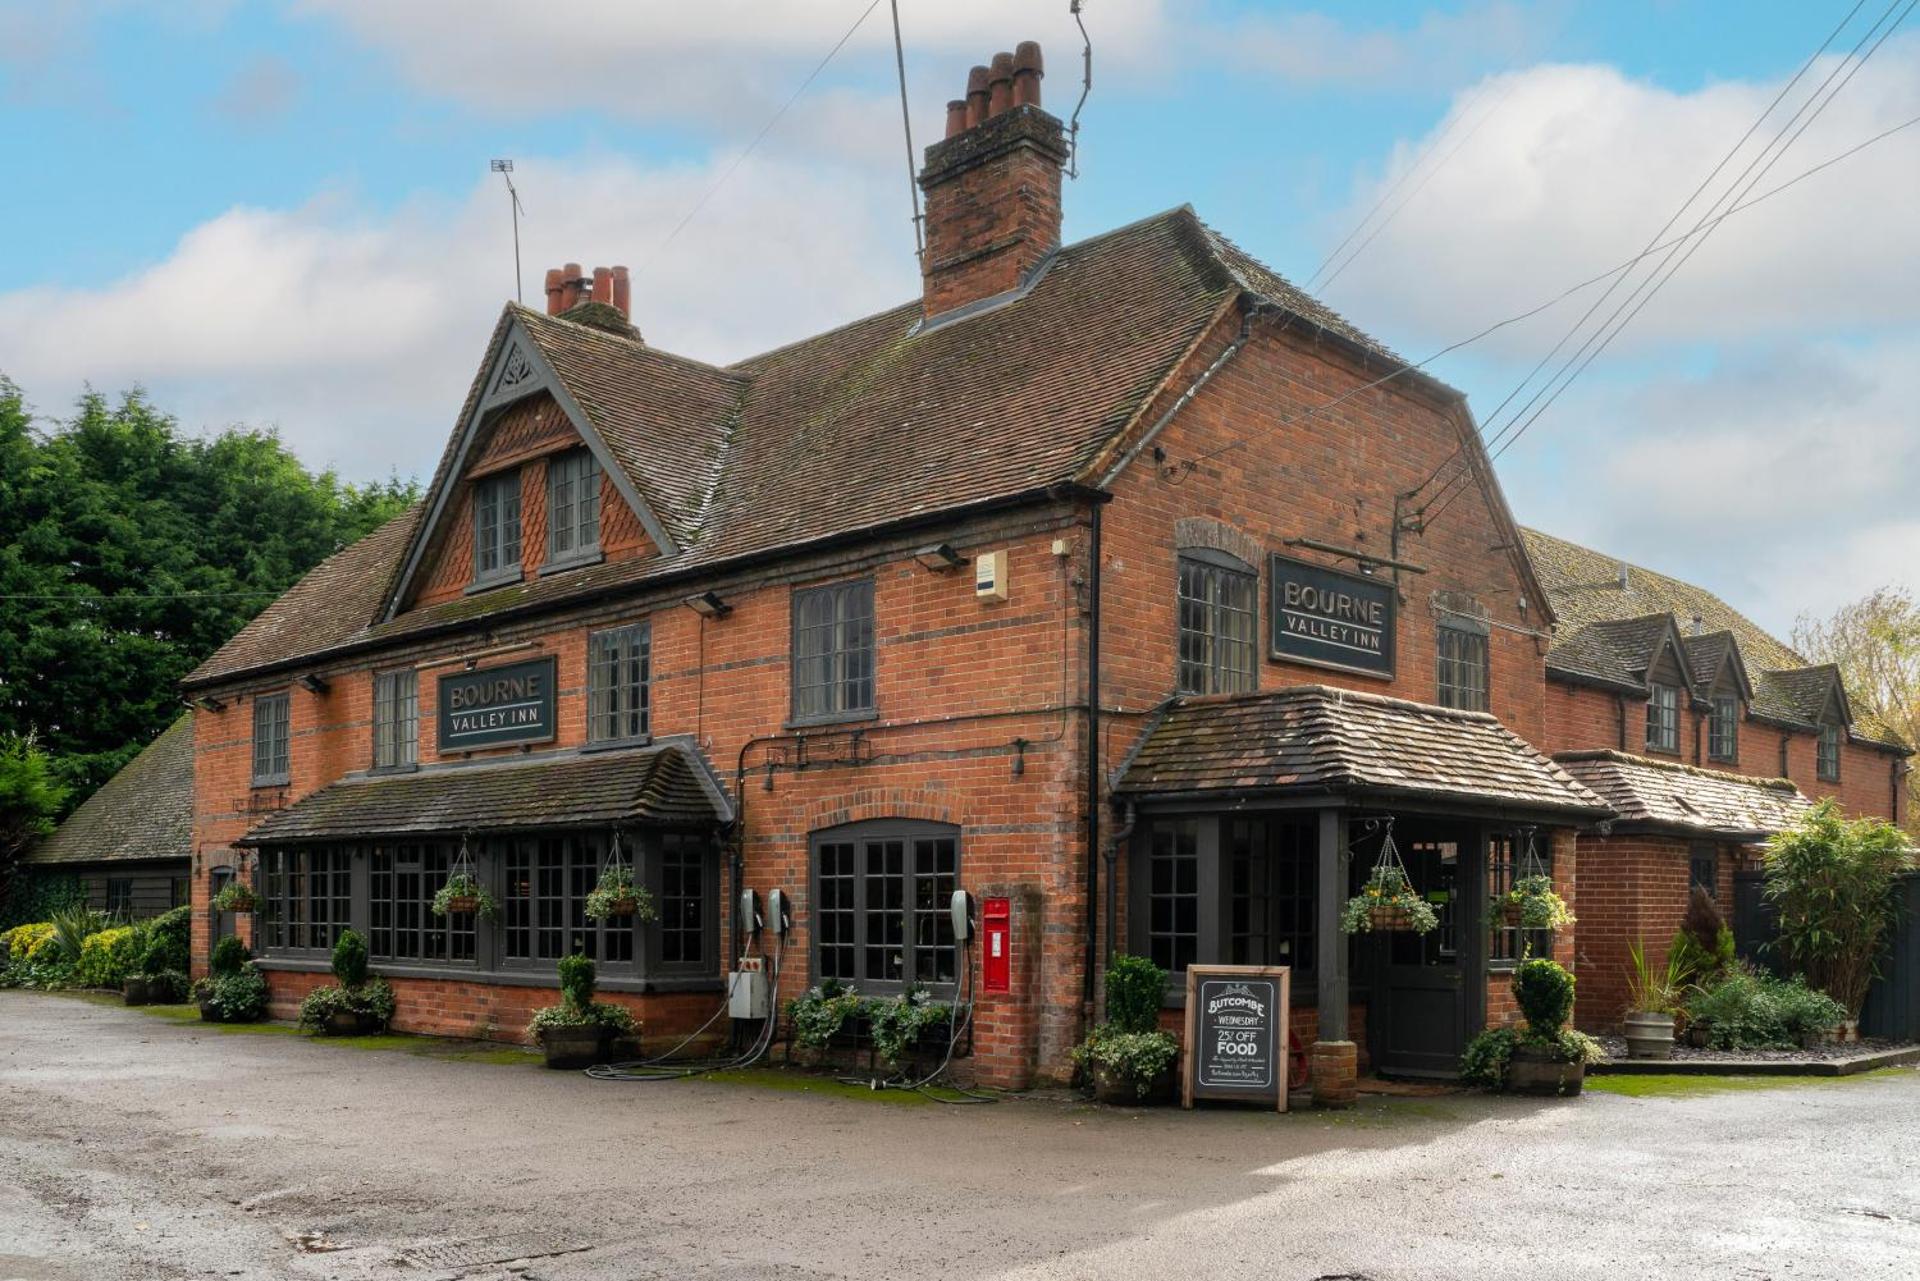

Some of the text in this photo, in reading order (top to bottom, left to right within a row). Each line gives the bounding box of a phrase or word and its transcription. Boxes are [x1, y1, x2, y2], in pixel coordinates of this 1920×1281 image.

[1284, 581, 1384, 625] BOURNE
[1287, 616, 1380, 648] VALLEY INN
[450, 674, 540, 709] BOURNE
[452, 708, 537, 731] VALLEY INN
[1208, 997, 1265, 1017] BUTCOMBE
[1236, 1031, 1257, 1042] OFF
[1217, 1042, 1258, 1056] FOOD
